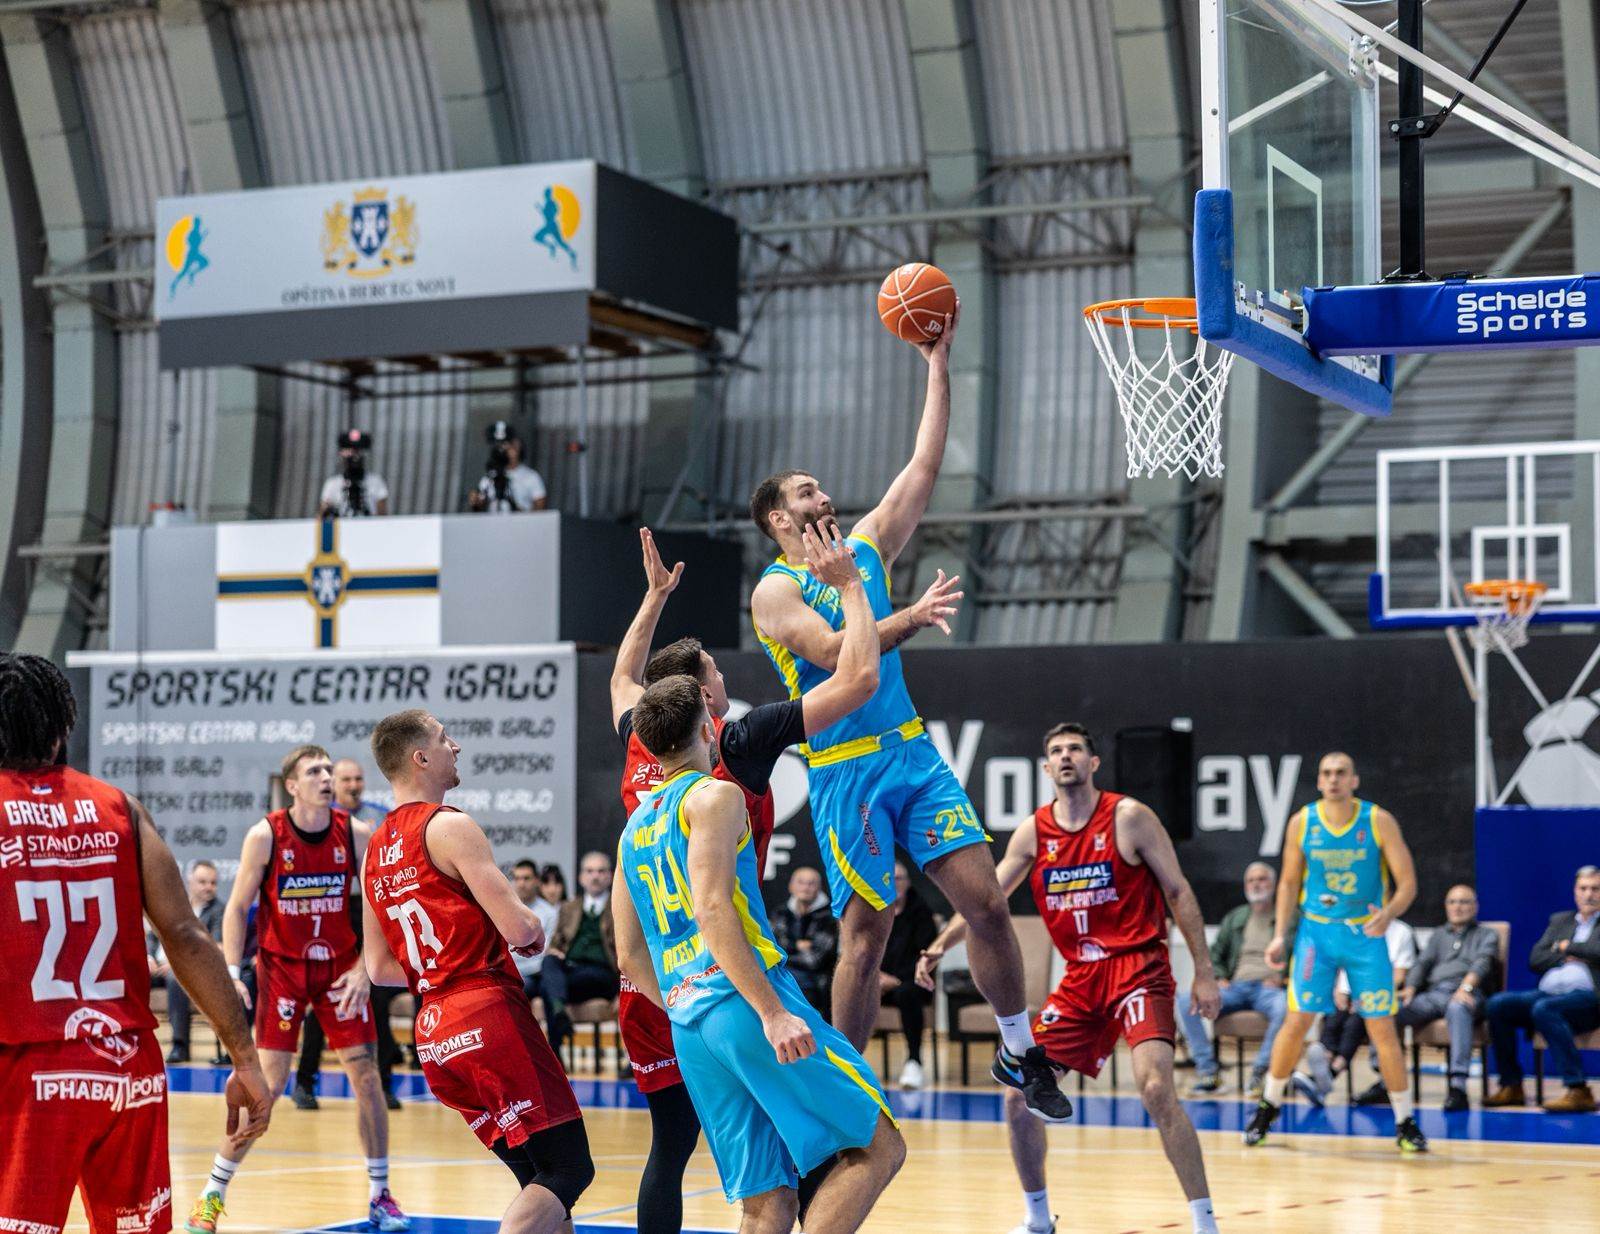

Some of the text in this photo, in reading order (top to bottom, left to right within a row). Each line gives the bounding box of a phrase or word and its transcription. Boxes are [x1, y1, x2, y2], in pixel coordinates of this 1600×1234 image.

[1457, 288, 1587, 314] Schelde
[1457, 309, 1587, 338] Sports
[104, 661, 559, 709] SPORTSKI CENTAR IGALO
[4, 799, 99, 829] GREEN JR
[934, 802, 982, 842] 24
[27, 831, 119, 852] STANDARD
[1049, 863, 1112, 884] ADMIRAL
[311, 914, 322, 938] 7
[1072, 909, 1089, 935] 17
[15, 877, 125, 1001] 22
